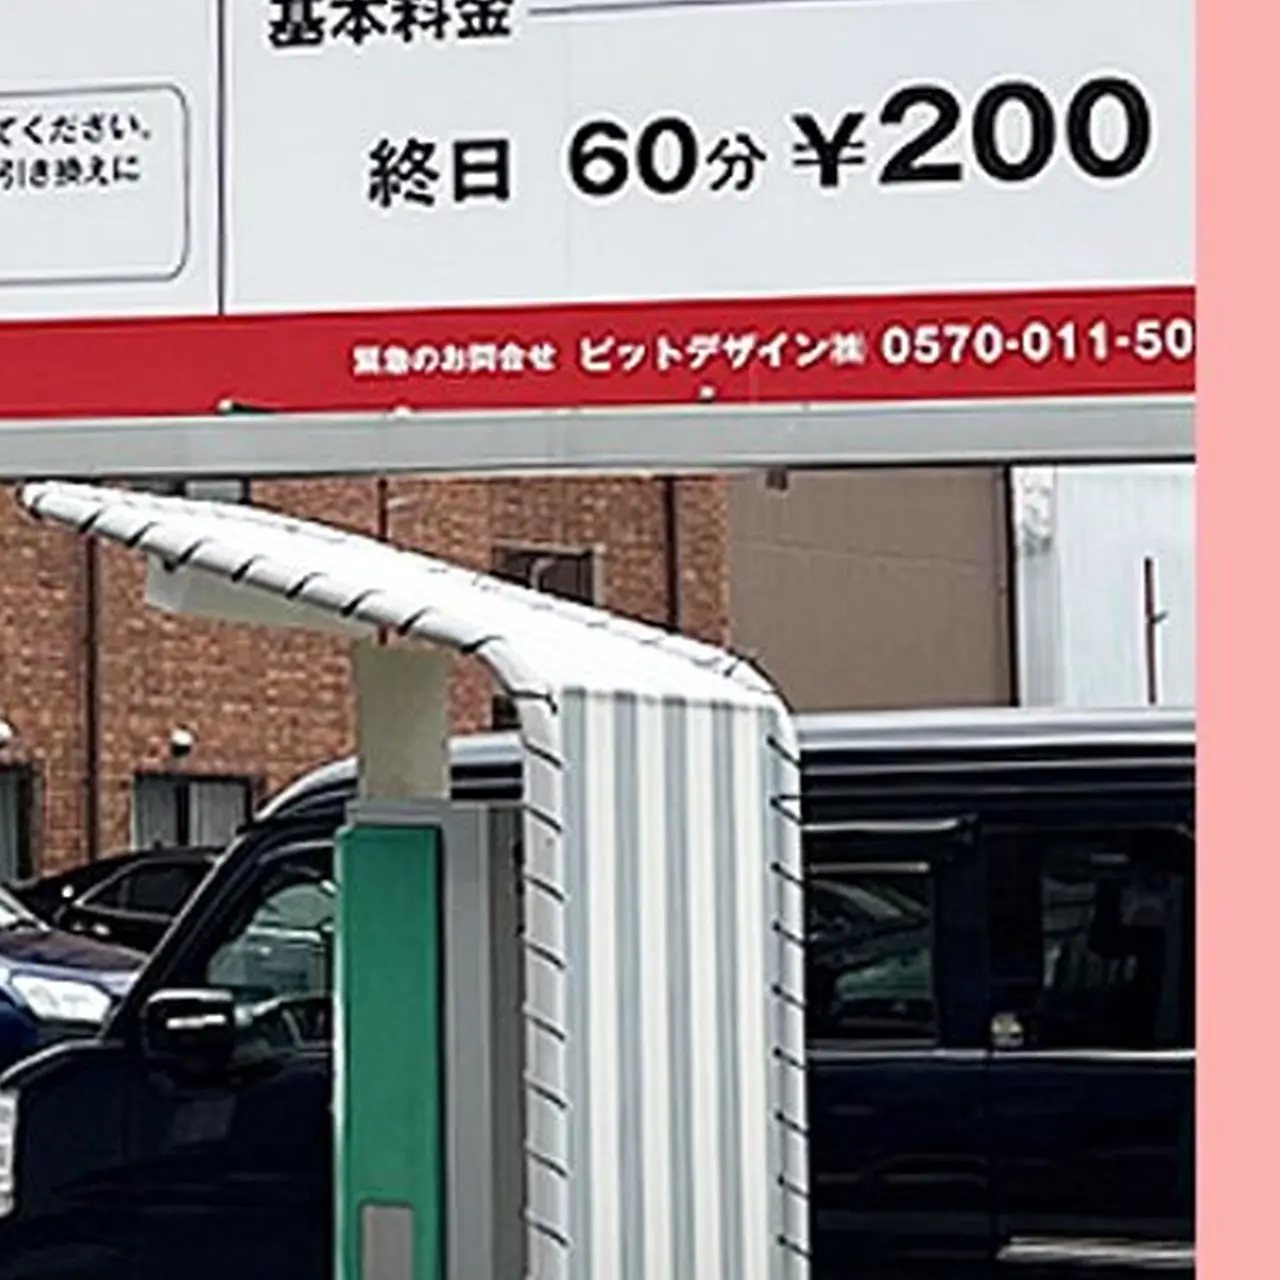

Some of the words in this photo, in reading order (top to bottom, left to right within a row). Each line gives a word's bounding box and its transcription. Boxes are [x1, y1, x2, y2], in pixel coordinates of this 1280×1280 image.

[368, 137, 512, 208] 終日
[568, 117, 767, 196] 60分
[792, 77, 1152, 188] ¥200
[881, 318, 1194, 364] 0570-011-50
